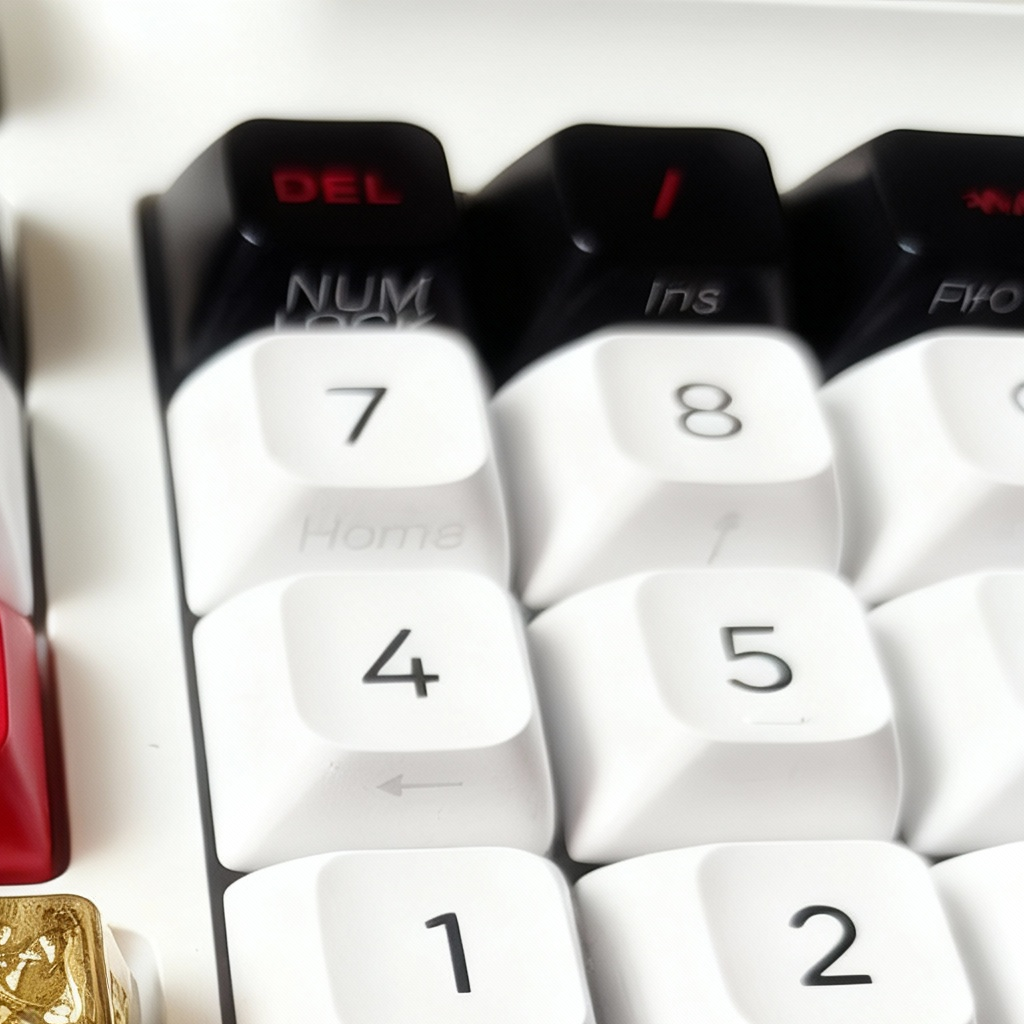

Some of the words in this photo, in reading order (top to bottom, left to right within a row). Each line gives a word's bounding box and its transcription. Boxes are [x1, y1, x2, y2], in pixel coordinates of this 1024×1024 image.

[273, 170, 401, 204] DEL
[285, 273, 433, 317] NUM
[643, 281, 721, 315] Ins
[326, 386, 389, 446] 7
[672, 382, 744, 439] 8
[361, 628, 441, 699] 4
[719, 625, 794, 694] 5
[424, 911, 473, 994] 1
[788, 904, 874, 987] 2
